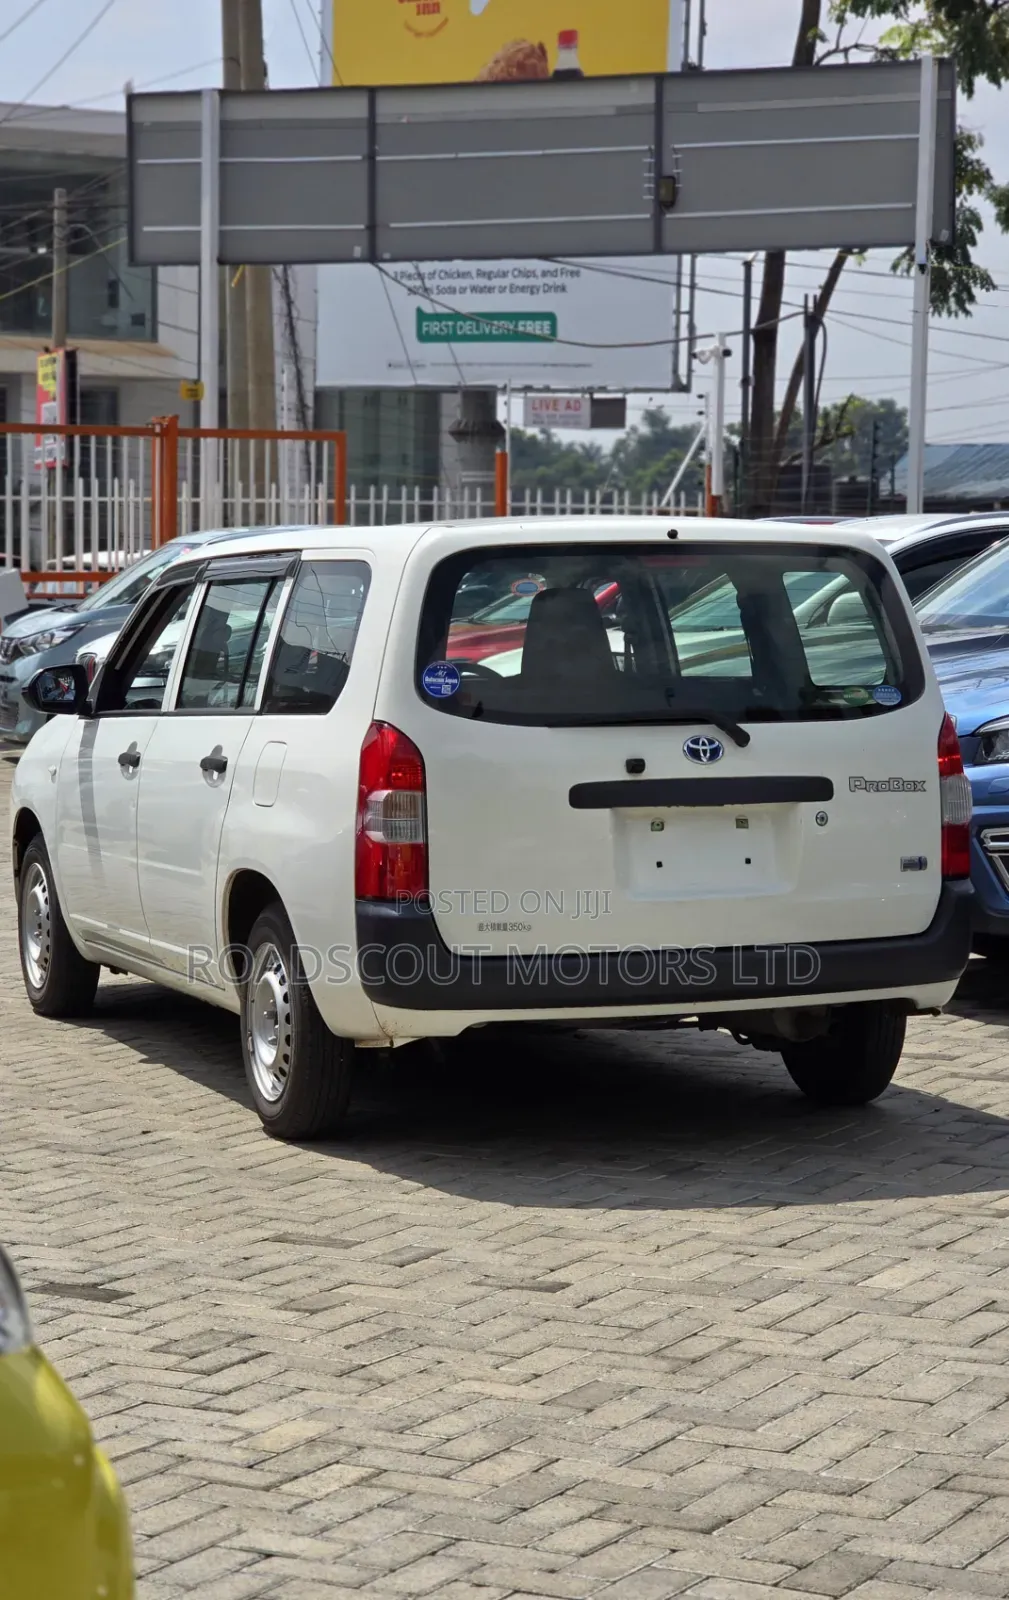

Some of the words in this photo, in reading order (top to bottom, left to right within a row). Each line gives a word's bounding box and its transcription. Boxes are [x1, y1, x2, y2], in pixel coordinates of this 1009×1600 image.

[428, 270, 437, 280] of
[476, 268, 510, 280] Regular
[511, 268, 539, 279] Chips,
[541, 268, 559, 278] and
[560, 267, 581, 278] Free
[436, 285, 457, 295] Soda
[459, 286, 467, 295] or
[469, 284, 496, 294] Water
[498, 284, 507, 294] or
[509, 283, 540, 296] Energy
[542, 281, 568, 294] Drink
[422, 321, 454, 336] FIRST
[456, 320, 516, 336] DELIVERY
[518, 320, 552, 335] FREE
[532, 399, 559, 411] LIVE
[564, 399, 582, 411] AD
